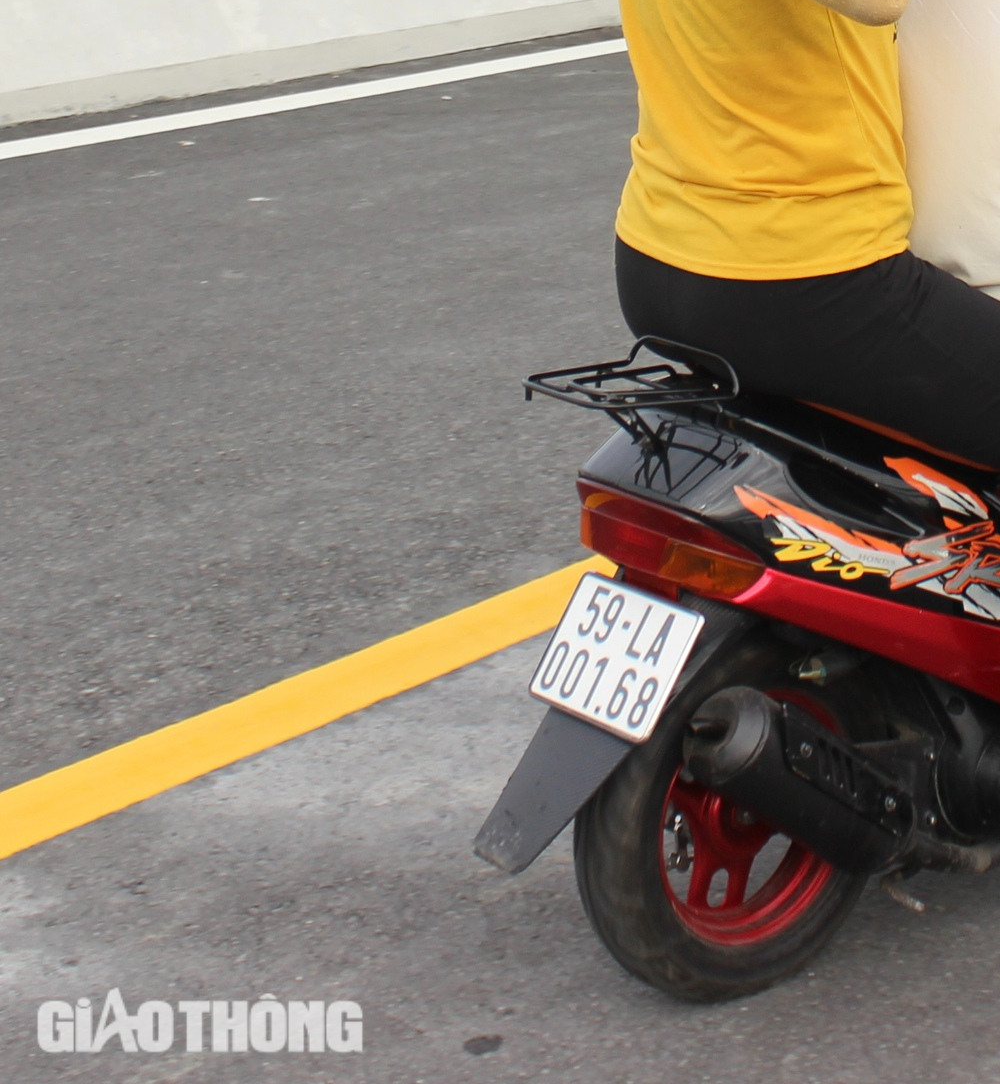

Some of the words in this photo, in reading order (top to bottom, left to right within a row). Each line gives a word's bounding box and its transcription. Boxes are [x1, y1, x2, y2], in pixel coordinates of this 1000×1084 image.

[770, 538, 890, 580] Dio
[577, 585, 677, 667] 59-LA
[539, 641, 659, 729] 001.68
